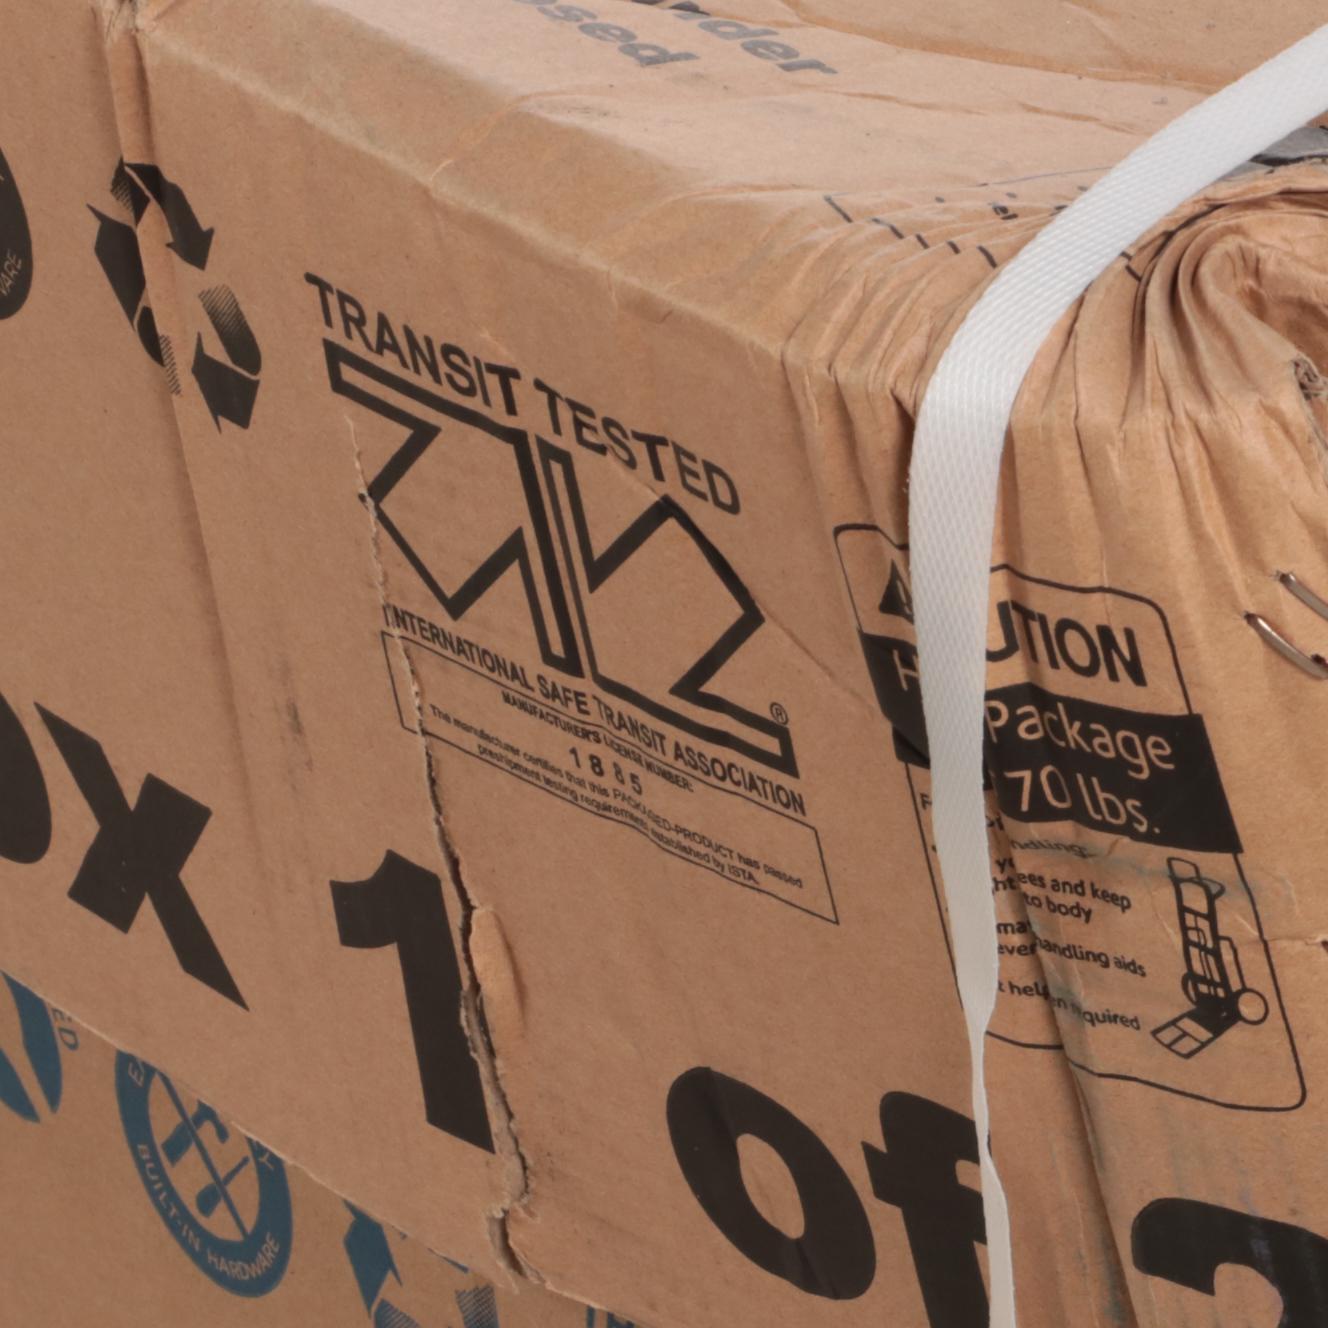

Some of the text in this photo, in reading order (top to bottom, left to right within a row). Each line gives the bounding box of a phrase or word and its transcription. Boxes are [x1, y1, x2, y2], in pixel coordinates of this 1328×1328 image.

[304, 271, 742, 515] TRANSIT TESTED
[384, 602, 807, 817] INTERNATIONAL SAFE TRANSIT ASSOCIATION
[984, 699, 1176, 779] Package
[603, 732, 643, 768] LICENSE
[430, 703, 451, 724] The
[453, 716, 521, 756] manufacturer
[523, 751, 564, 779] certifies
[564, 769, 586, 789] that
[589, 779, 611, 798] this
[737, 852, 761, 870] has
[763, 863, 804, 889] passed
[477, 744, 542, 783] preshipment
[543, 774, 578, 802] testing
[651, 826, 711, 864] established
[1003, 765, 1162, 837] 70 lbs.
[1046, 895, 1093, 924] body
[1050, 875, 1132, 913] and keep
[330, 850, 496, 1156] 1
[1114, 954, 1147, 977] aids
[137, 1143, 202, 1251] BUILT-IN
[206, 1231, 280, 1281] HARDWARE
